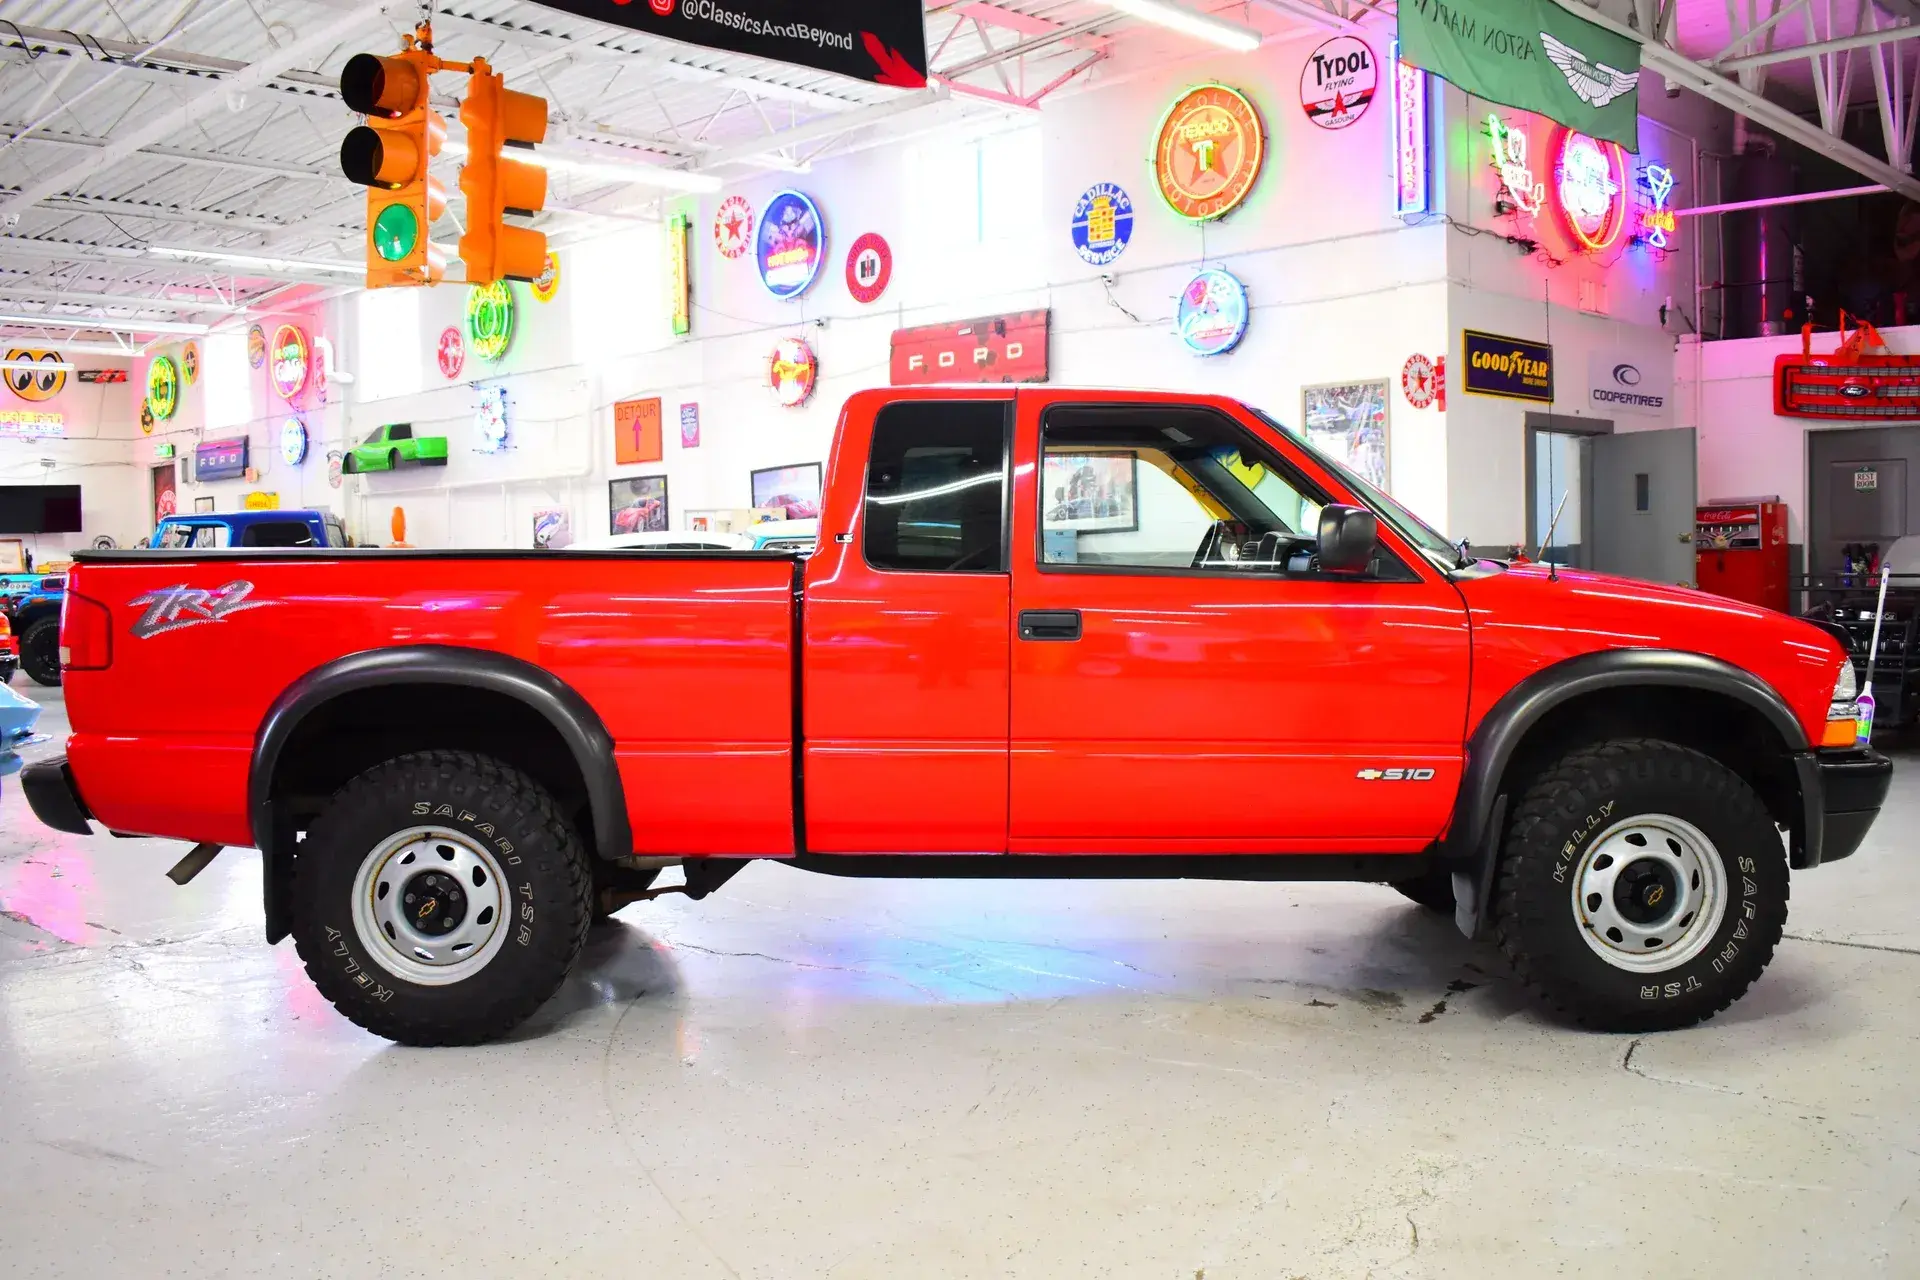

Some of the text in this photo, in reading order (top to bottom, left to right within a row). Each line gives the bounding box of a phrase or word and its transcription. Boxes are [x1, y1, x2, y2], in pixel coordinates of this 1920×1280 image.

[681, 0, 853, 50] @ClassicsAndBeyond
[1313, 50, 1369, 86] TYDOL
[1324, 77, 1355, 92] FLYING
[1325, 114, 1356, 127] GASOLINE
[1075, 183, 1131, 218] CADILLAC
[1079, 238, 1127, 265] SERVICE
[908, 342, 1024, 372] FORD
[1472, 350, 1548, 379] GOODYEAR
[617, 402, 656, 421] DETOUR
[1593, 388, 1663, 408] COOPERTIRES
[200, 453, 237, 467] FORD
[1856, 480, 1875, 488] ROOM
[1857, 472, 1874, 481] REST
[836, 534, 853, 543] LS
[1382, 768, 1435, 780] S10
[1552, 800, 1615, 883] KELLY
[412, 801, 535, 947] SAFARI TSR
[1640, 855, 1758, 1000] SAFARI TSR
[325, 925, 394, 1002] KELLY
